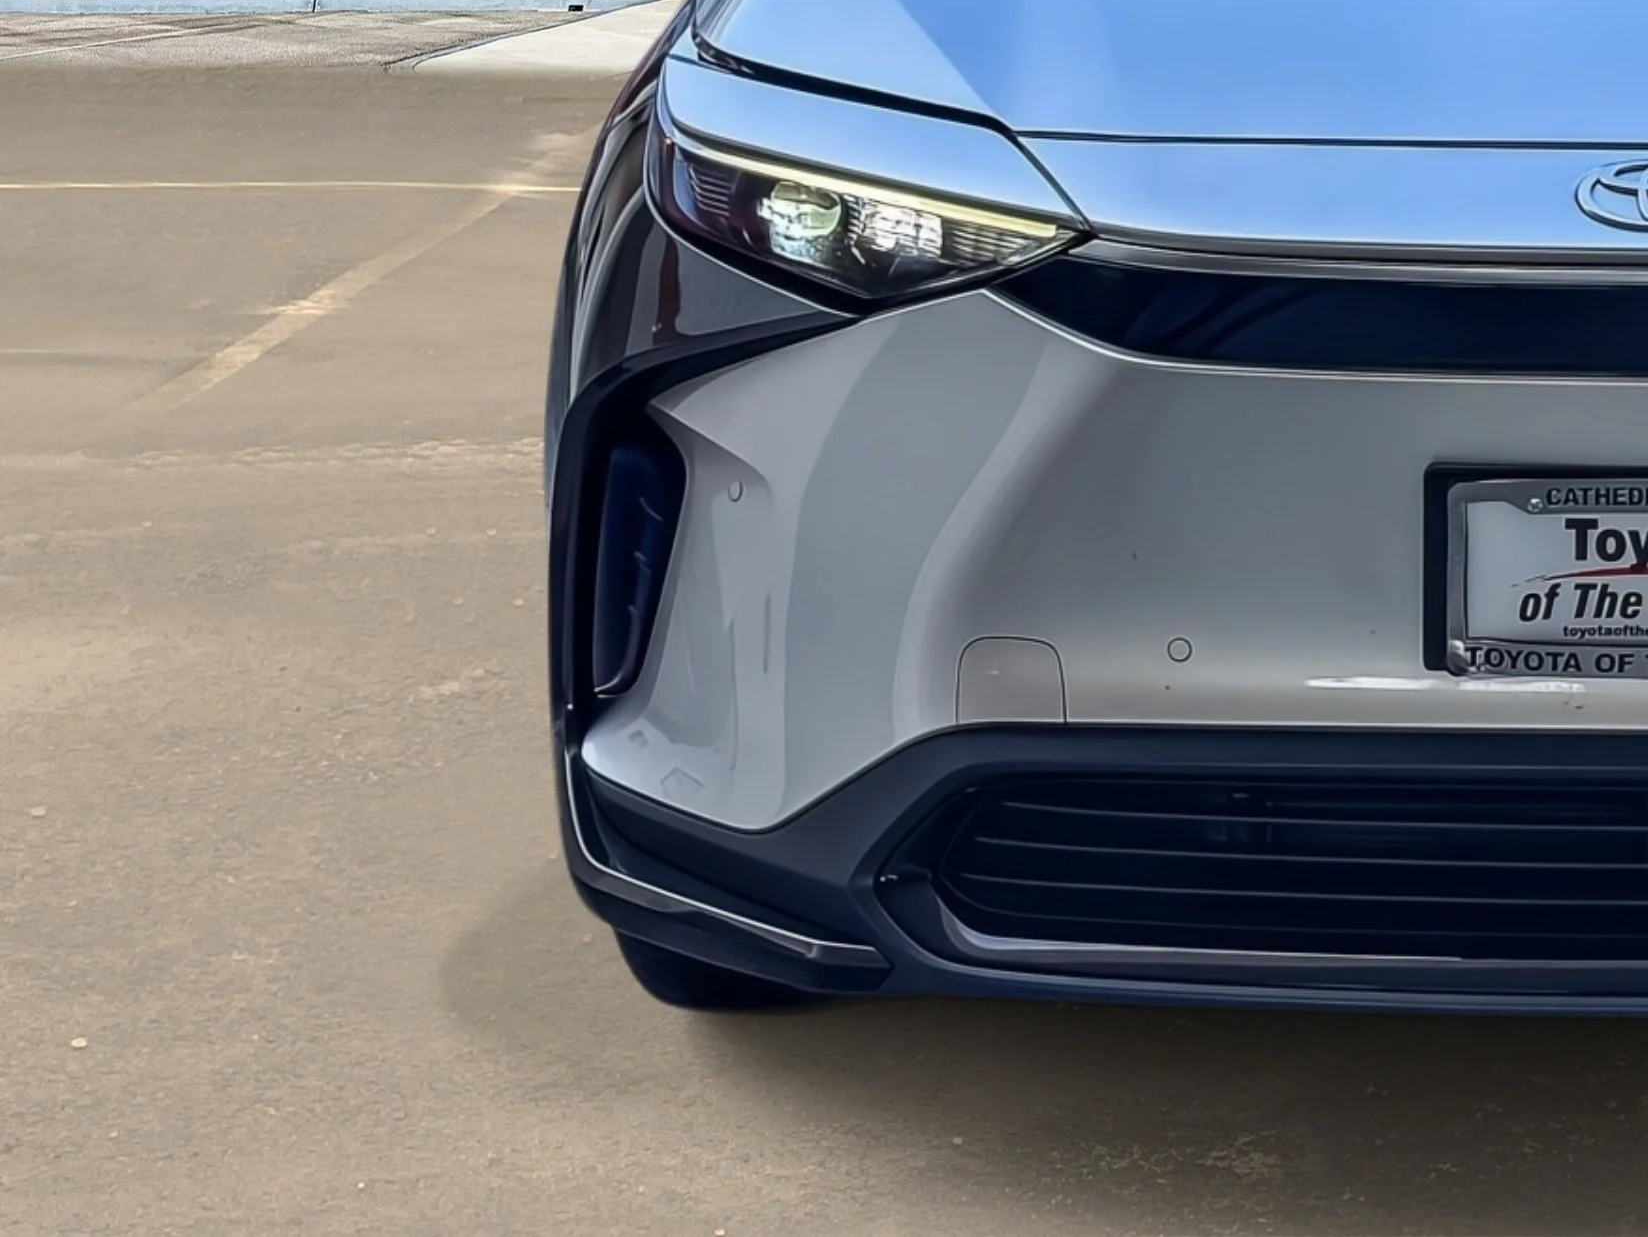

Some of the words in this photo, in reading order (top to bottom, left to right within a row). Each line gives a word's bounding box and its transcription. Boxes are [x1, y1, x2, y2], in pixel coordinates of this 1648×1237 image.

[1518, 583, 1561, 622] of
[1574, 583, 1643, 620] The
[1465, 646, 1582, 673] TOYOTA
[1594, 653, 1635, 675] OF
